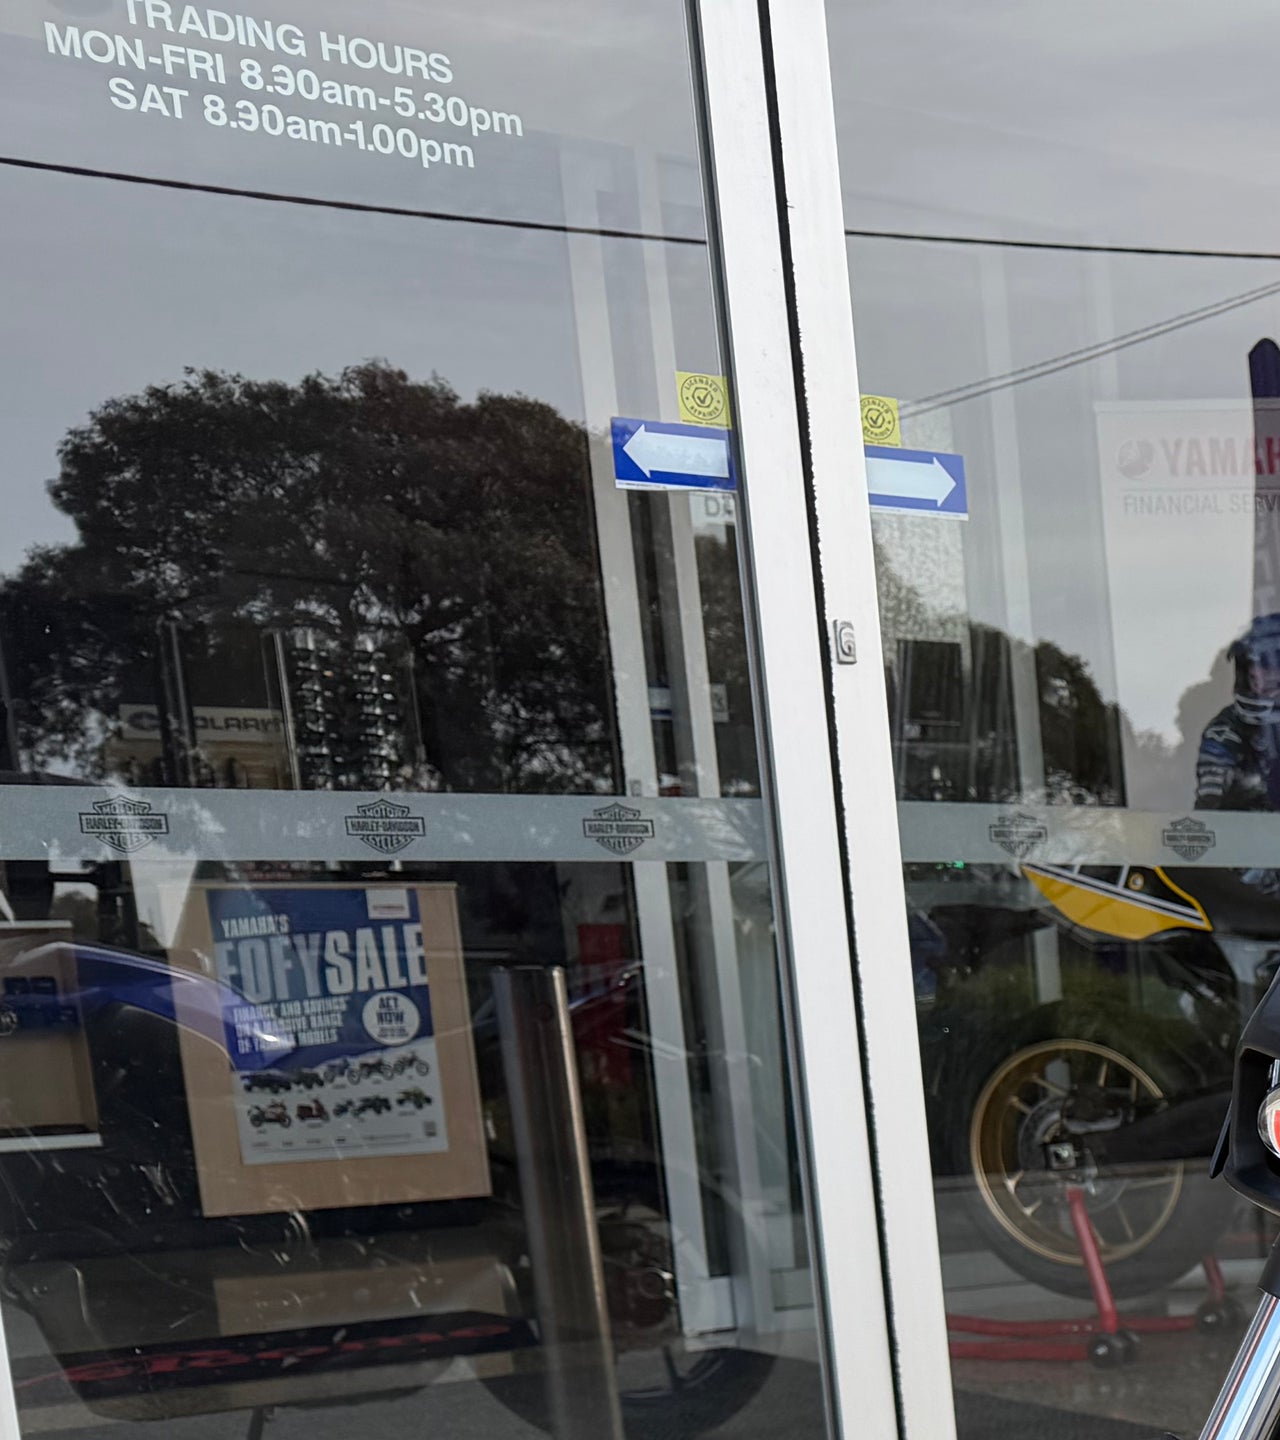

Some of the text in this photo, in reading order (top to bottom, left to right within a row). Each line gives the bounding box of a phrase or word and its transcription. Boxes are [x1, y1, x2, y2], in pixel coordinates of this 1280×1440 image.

[44, 21, 523, 136] MON-FRI 8.30am-5.30pm
[126, 0, 453, 84] TRADING HOURS
[108, 77, 475, 168] SAT 8.30am-1.00pm
[1124, 495, 1224, 516] FINANCIAL
[221, 914, 290, 939] YAMAHA'S
